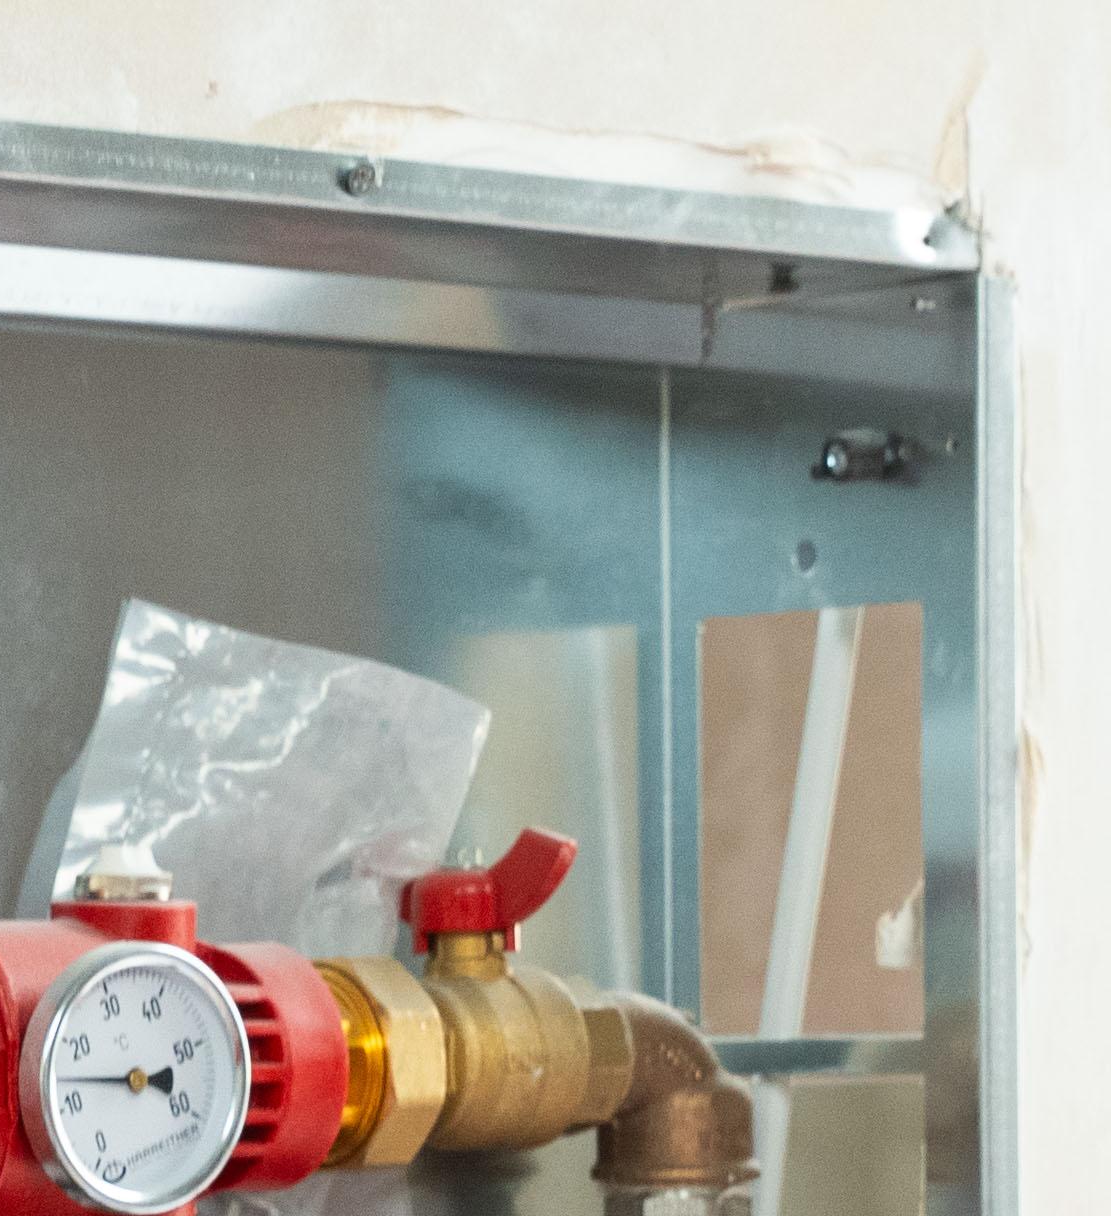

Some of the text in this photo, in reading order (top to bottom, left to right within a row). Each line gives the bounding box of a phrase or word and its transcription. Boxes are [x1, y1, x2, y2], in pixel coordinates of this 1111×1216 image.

[101, 995, 120, 1021] 30
[142, 996, 161, 1022] 40
[71, 1034, 90, 1061] 20
[174, 1038, 194, 1064] 50
[65, 1091, 82, 1116] 10
[169, 1091, 190, 1117] 60
[95, 1131, 107, 1153] 0
